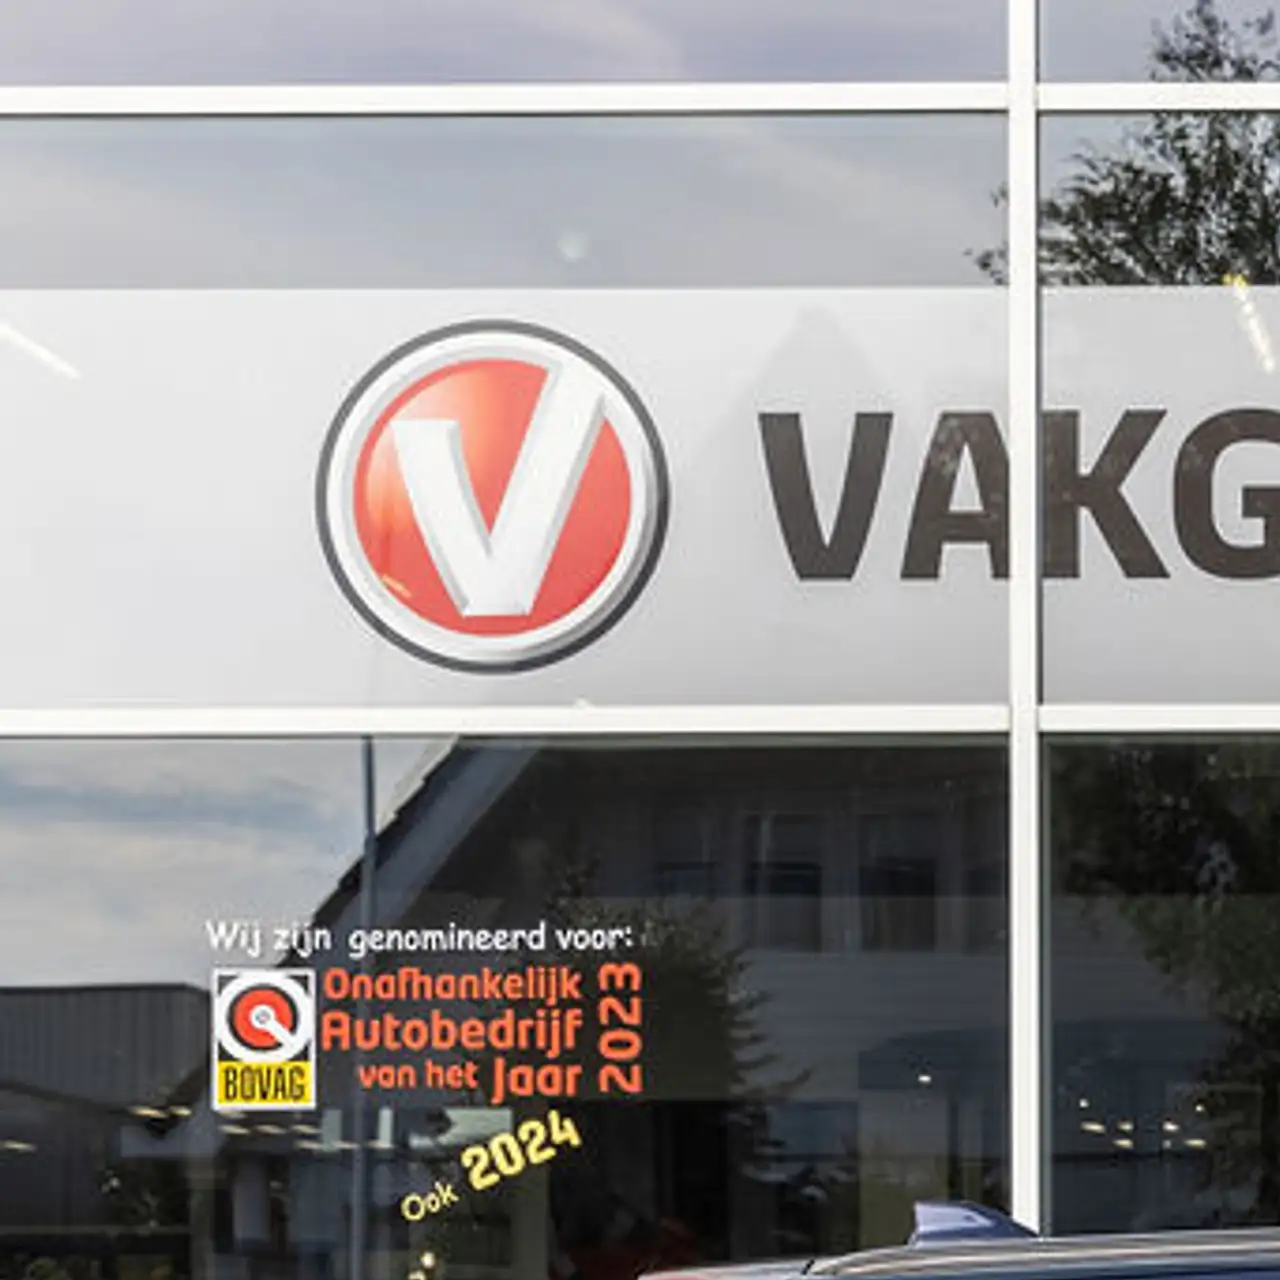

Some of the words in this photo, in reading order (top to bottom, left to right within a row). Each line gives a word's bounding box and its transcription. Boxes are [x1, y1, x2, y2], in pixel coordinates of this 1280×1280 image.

[206, 920, 262, 957] Wij
[273, 922, 332, 957] zijn
[348, 921, 547, 958] genomineerd
[557, 922, 633, 951] voor:
[323, 966, 582, 1007] Onafhankelijk
[321, 1010, 583, 1059] Autobedrijf
[599, 963, 642, 1093] 2023
[224, 1066, 306, 1102] BOVAG
[358, 1064, 415, 1089] van
[426, 1060, 477, 1089] het
[491, 1058, 581, 1104] Jaar
[401, 1181, 459, 1222] Ook
[461, 1110, 582, 1192] 2024
